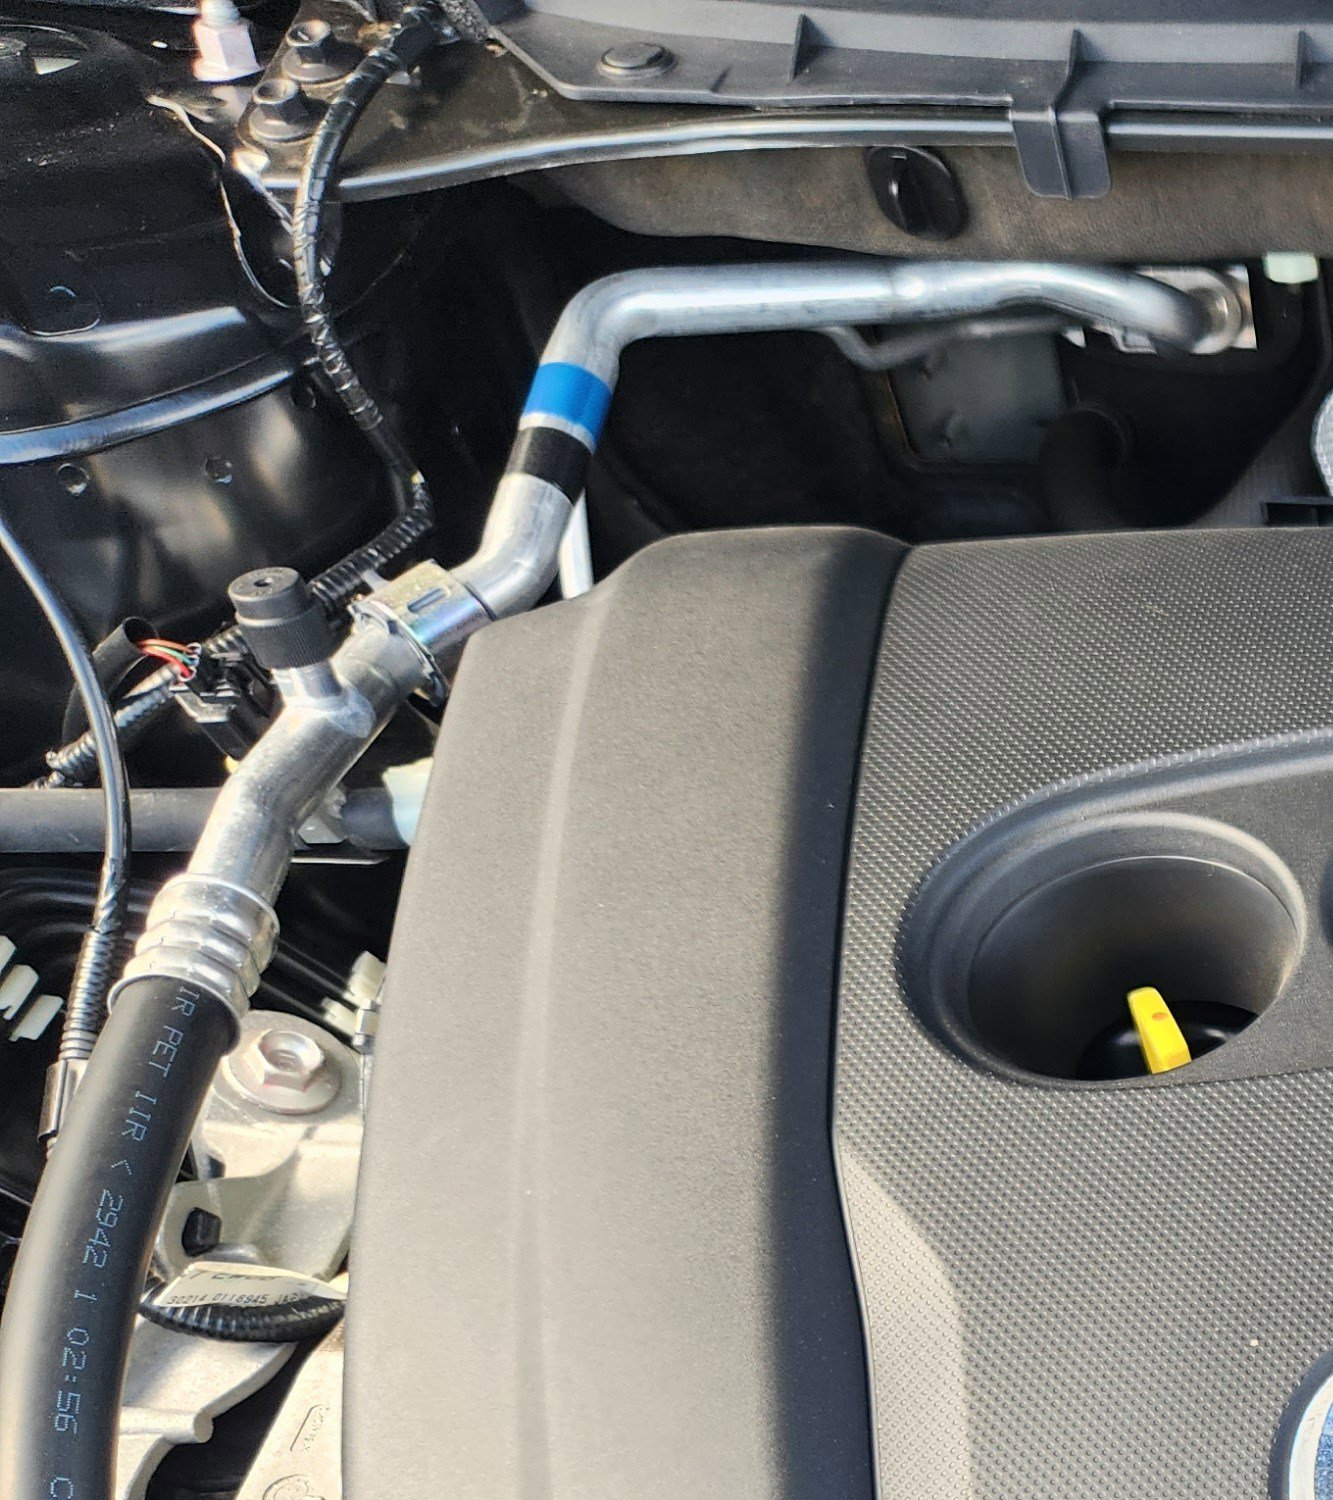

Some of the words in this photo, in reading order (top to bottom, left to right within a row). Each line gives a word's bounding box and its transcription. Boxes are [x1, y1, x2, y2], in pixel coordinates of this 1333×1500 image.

[149, 1025, 183, 1077] PET
[82, 1189, 123, 1269] 2942
[54, 1327, 90, 1434] 02:56
